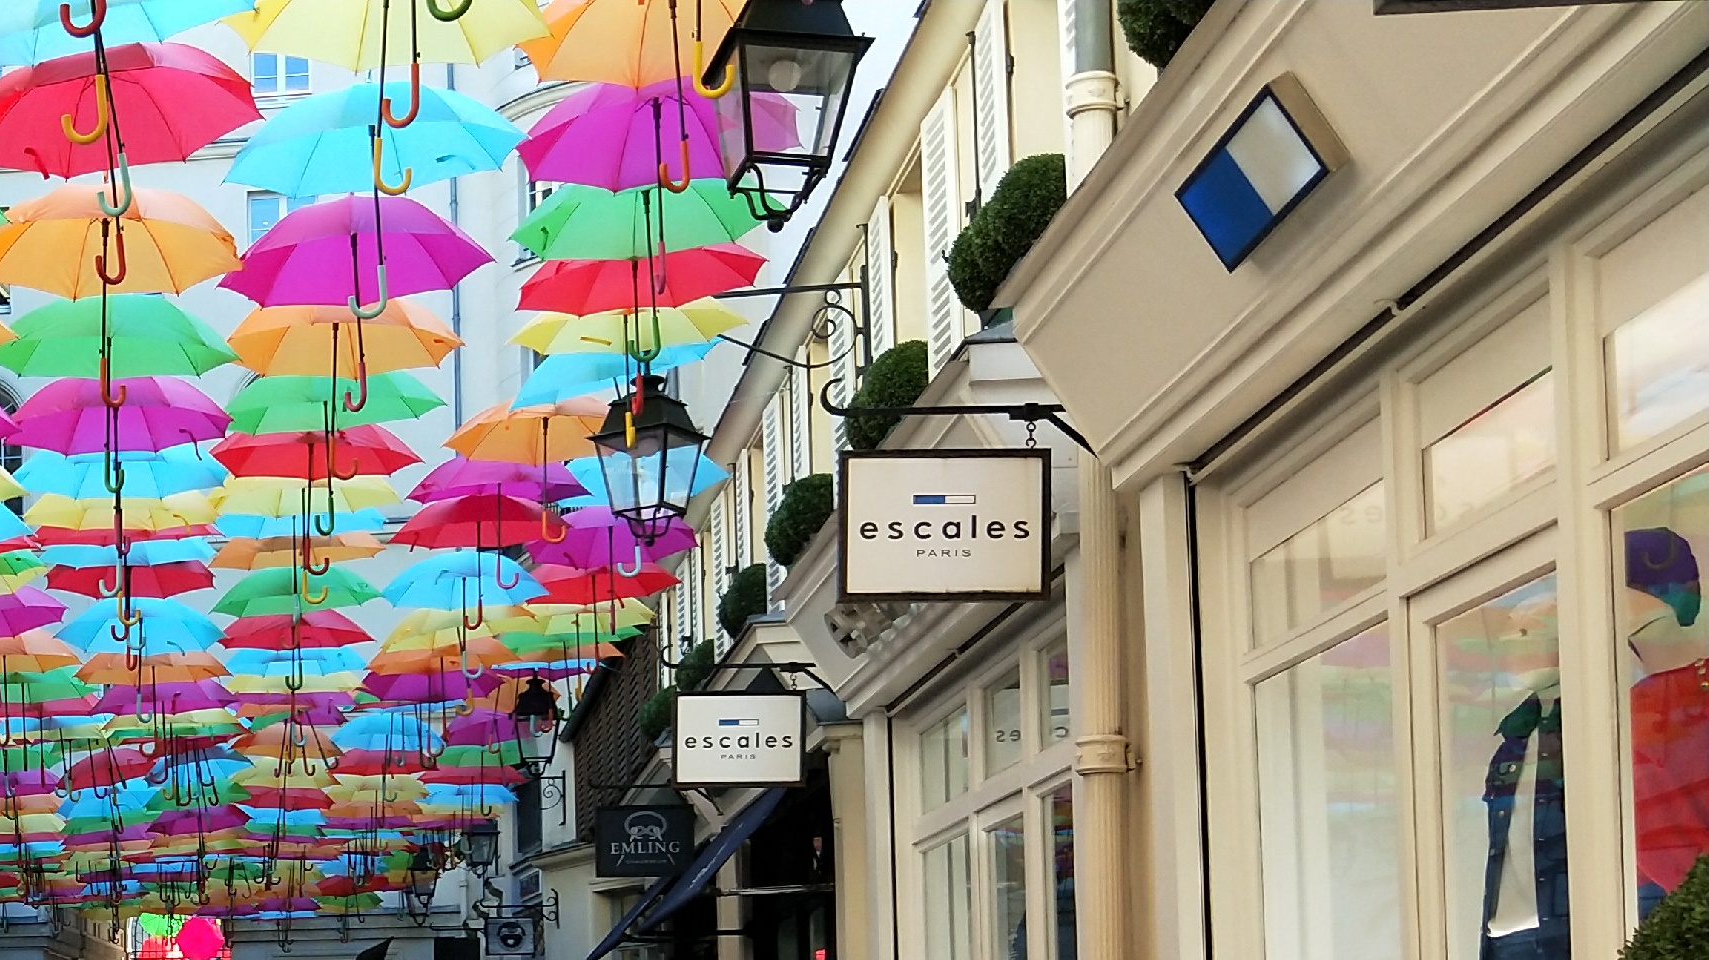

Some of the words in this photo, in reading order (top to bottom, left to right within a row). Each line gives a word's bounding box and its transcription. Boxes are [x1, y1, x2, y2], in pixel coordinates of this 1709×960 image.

[859, 514, 1030, 540] escales
[916, 549, 972, 558] PARIS
[684, 732, 793, 749] escales
[610, 841, 680, 855] EMLING
